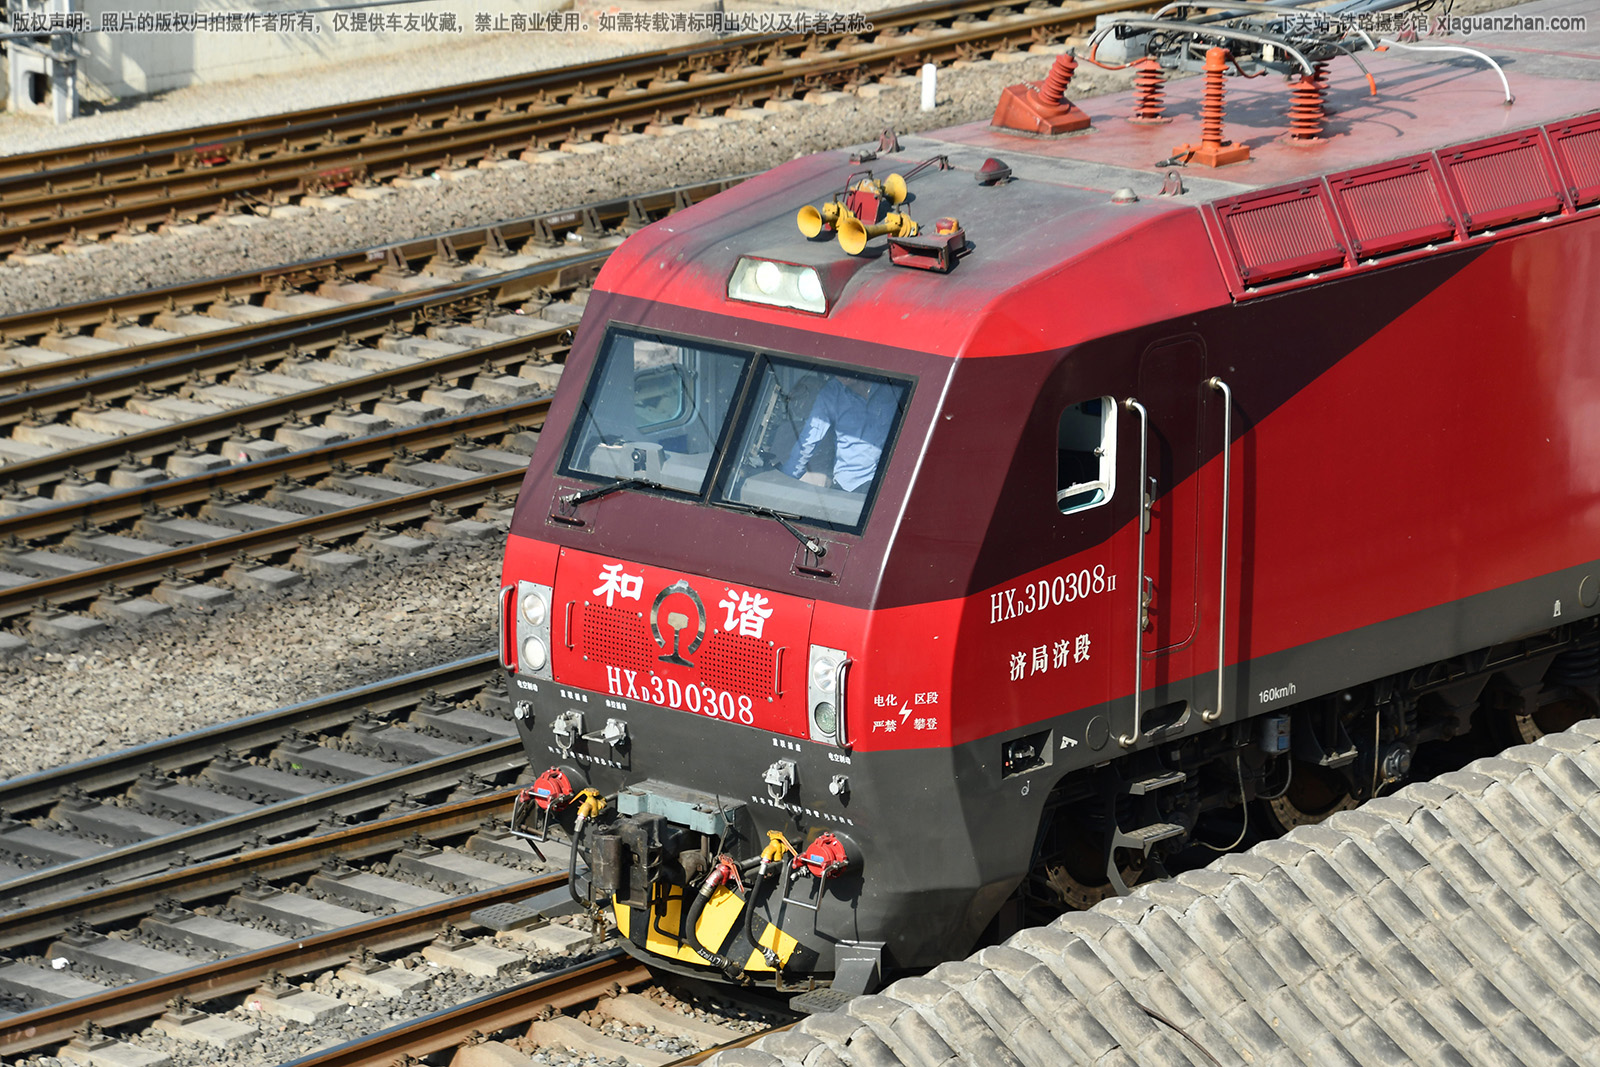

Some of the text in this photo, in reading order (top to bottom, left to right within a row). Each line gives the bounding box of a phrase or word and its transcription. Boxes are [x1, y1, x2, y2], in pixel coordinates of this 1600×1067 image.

[592, 563, 774, 640] 和 谐
[1009, 633, 1092, 681] 济局济段
[605, 665, 755, 726] HXD3D0308
[873, 691, 939, 707] 电化 区段
[1258, 682, 1297, 704] 160km/h
[872, 717, 938, 733] 严禁 攀登
